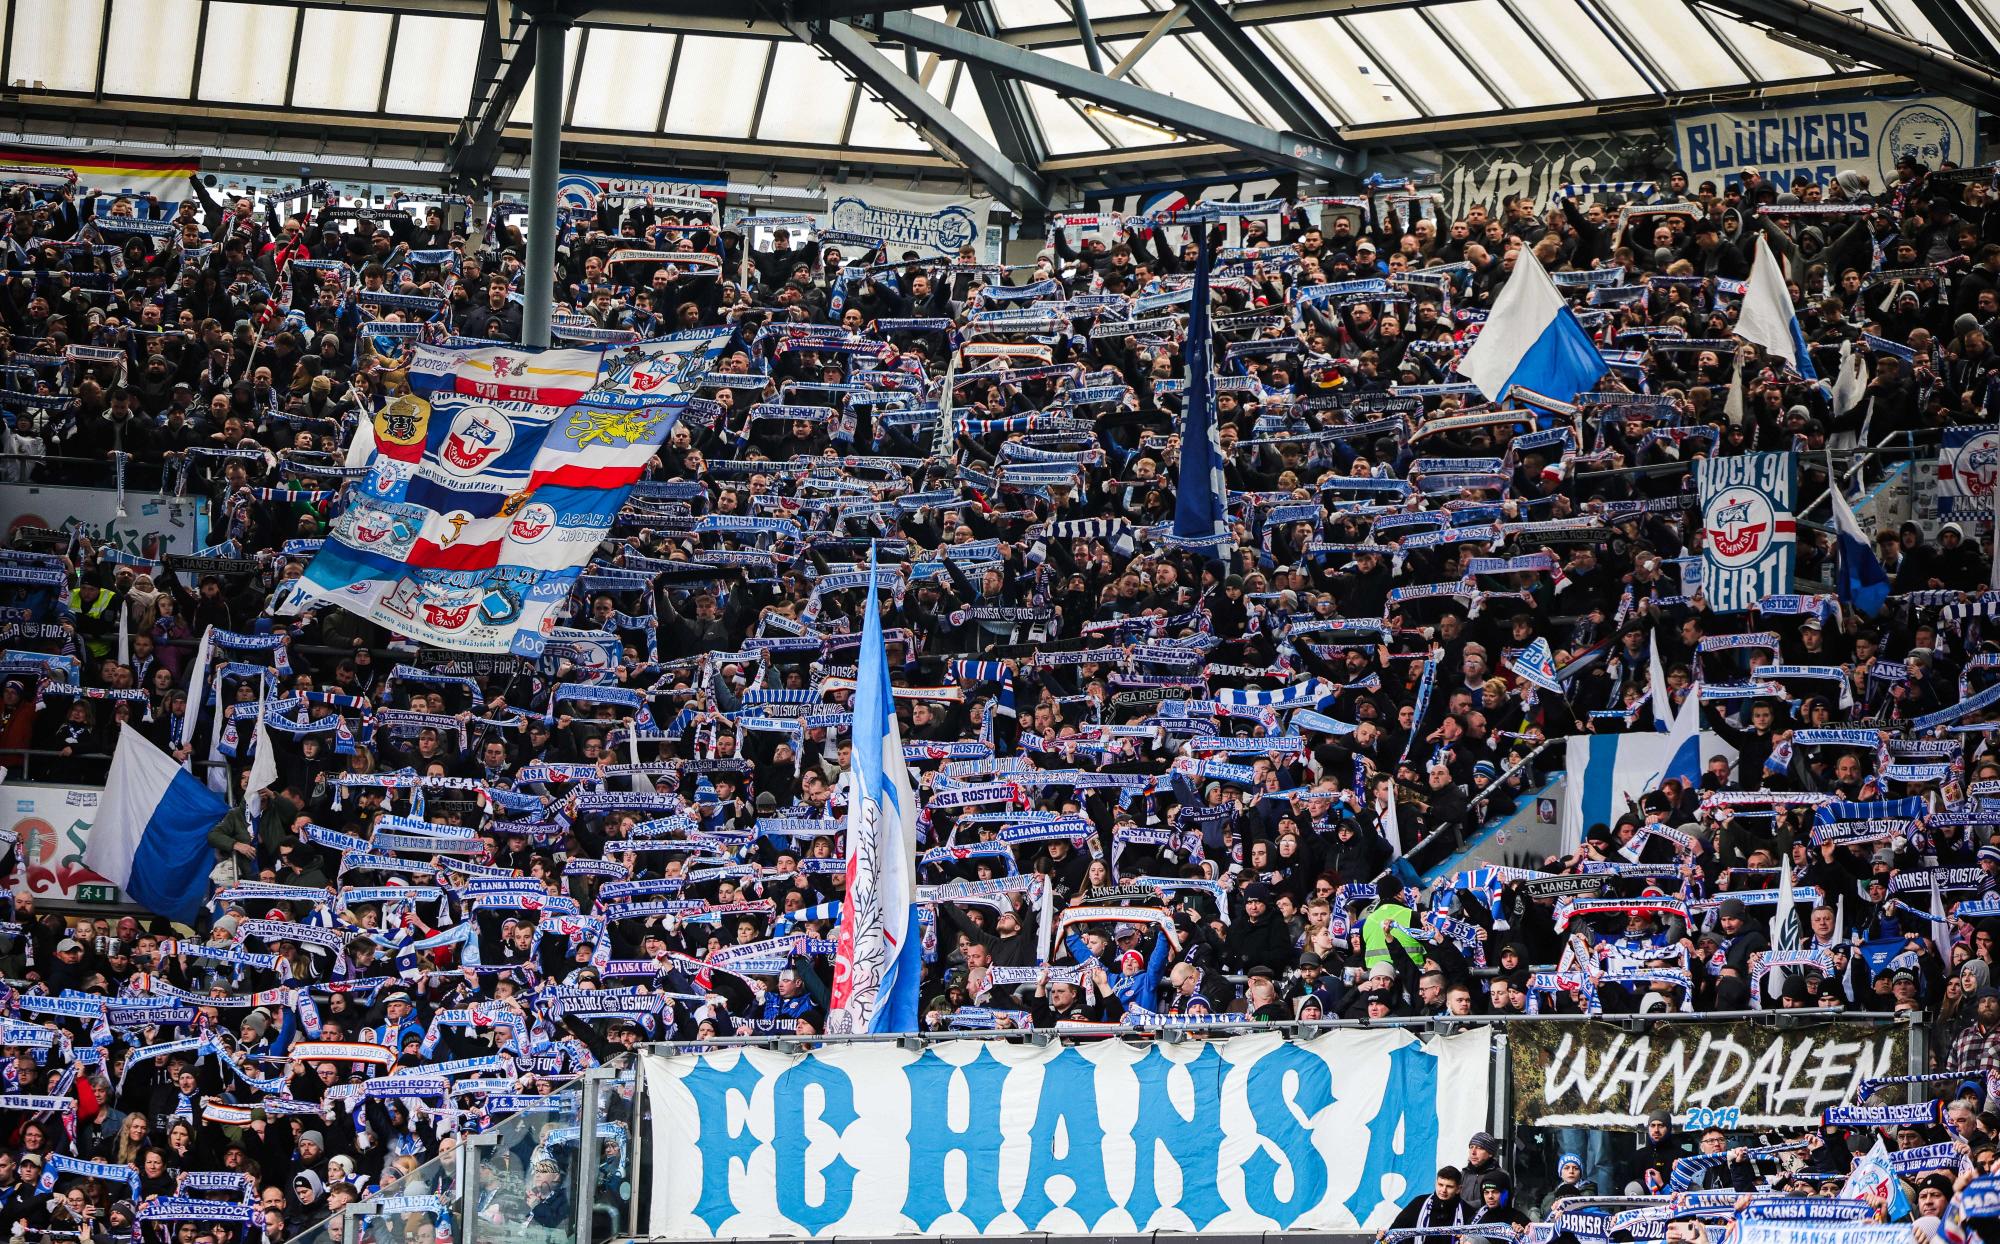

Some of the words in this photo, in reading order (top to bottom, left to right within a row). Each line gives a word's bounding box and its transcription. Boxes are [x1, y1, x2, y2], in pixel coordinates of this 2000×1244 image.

[1686, 111, 1870, 174] BLÜCHERS
[1453, 155, 1597, 222] IMPULS
[864, 211, 938, 232] HANSAFANS
[1066, 217, 1098, 226] Hansa
[846, 235, 881, 245] ROSTOCK
[863, 222, 937, 246] NEUKALEN
[367, 323, 396, 333] HANSA
[1217, 319, 1236, 331] FC
[1240, 316, 1282, 328] HANSA
[1087, 388, 1125, 399] ROSTOCK
[1309, 398, 1340, 409] HANSA
[784, 408, 817, 419] HANSA
[1052, 417, 1078, 429] HANSA
[724, 462, 758, 471] HANSA
[762, 462, 806, 471] ROSTOCK
[1762, 452, 1788, 506] 9A
[1609, 502, 1637, 510] HANSA
[1650, 496, 1678, 509] HANSA
[1952, 496, 1993, 511] HANSA
[719, 517, 754, 528] HANSA
[1411, 533, 1441, 546] HANSA
[183, 559, 216, 570] HANSA
[1476, 559, 1505, 571] HANSA
[826, 576, 853, 588] HANSA
[1017, 608, 1052, 619] ROSTOCK
[1054, 654, 1083, 664] HANSA
[1086, 651, 1124, 661] ROSTOCK
[1140, 689, 1185, 700] ROSTOCK
[402, 714, 427, 724] HANSA
[429, 716, 458, 728] ROSTOCK
[1159, 719, 1186, 730] Hansa
[1809, 731, 1841, 742] HANSA
[1890, 740, 1915, 752] HANSA
[522, 769, 545, 780] NSA
[1887, 766, 1911, 775] HANSA
[1913, 765, 1946, 775] ROSTOCK
[579, 795, 618, 804] ROSTOCK
[623, 794, 650, 804] HANSA
[963, 788, 1015, 802] ROSTOCK
[392, 817, 432, 831] HANSA
[1821, 822, 1851, 838] HANSA
[1869, 819, 1909, 836] ROSTOCK
[1002, 830, 1015, 840] F.C.
[1016, 826, 1044, 838] HANSA
[1047, 822, 1085, 834] ROSTOCK
[319, 830, 348, 847] HANSA
[468, 866, 511, 875] ROSTOCK
[468, 882, 484, 891] F.C.
[486, 882, 508, 891] HANSA
[510, 882, 544, 891] ROSTOCK
[635, 880, 682, 891] ROSTOCK
[1540, 882, 1576, 894] HANSA
[1578, 878, 1607, 889] ROST
[1896, 873, 1931, 888] HANSA
[380, 890, 396, 898] aus
[1091, 887, 1120, 897] HANSA
[1122, 885, 1151, 895] ROSTO
[1660, 899, 1683, 911] Welt
[1071, 908, 1109, 917] HANSA
[243, 924, 256, 933] FC
[258, 924, 294, 935] HANSA
[180, 942, 197, 951] F.C.
[200, 946, 230, 958] HANSA
[231, 952, 275, 968] ROSTOCK
[731, 946, 754, 958] DEN
[756, 941, 775, 954] FÜR
[610, 964, 642, 972] HANSA
[1010, 968, 1038, 980] HANSA
[156, 982, 170, 991] F.C.
[172, 987, 198, 998] HANSA
[20, 1001, 52, 1012] HANSA
[564, 997, 602, 1011] FOREVER
[621, 998, 653, 1009] HANSA
[113, 1012, 146, 1021] HANSA
[149, 1010, 189, 1021] ROSTOCK
[18, 1030, 34, 1041] F.C.
[314, 1045, 350, 1056] HANSA
[517, 1059, 534, 1068] 1965
[1544, 1032, 1894, 1117] WANDALEN
[367, 1080, 406, 1088] HANSA
[5, 1096, 24, 1108] FÜR
[26, 1097, 56, 1108] DEN
[491, 1098, 511, 1109] F.C.
[1828, 1108, 1850, 1119] F.C.
[1850, 1106, 1886, 1119] HANSA
[1890, 1103, 1932, 1118] ROSTOCK
[1685, 1106, 1739, 1130] 2019
[681, 1051, 860, 1234] FC
[901, 1039, 1438, 1234] HANSA
[151, 1205, 192, 1216] HANSA
[194, 1205, 249, 1216] ROSTOCK
[1764, 1204, 1804, 1219] HANSA
[1809, 1204, 1869, 1220] ROSTOCK
[1561, 1214, 1602, 1234] HANSA
[1791, 1232, 1835, 1244] HANSA
